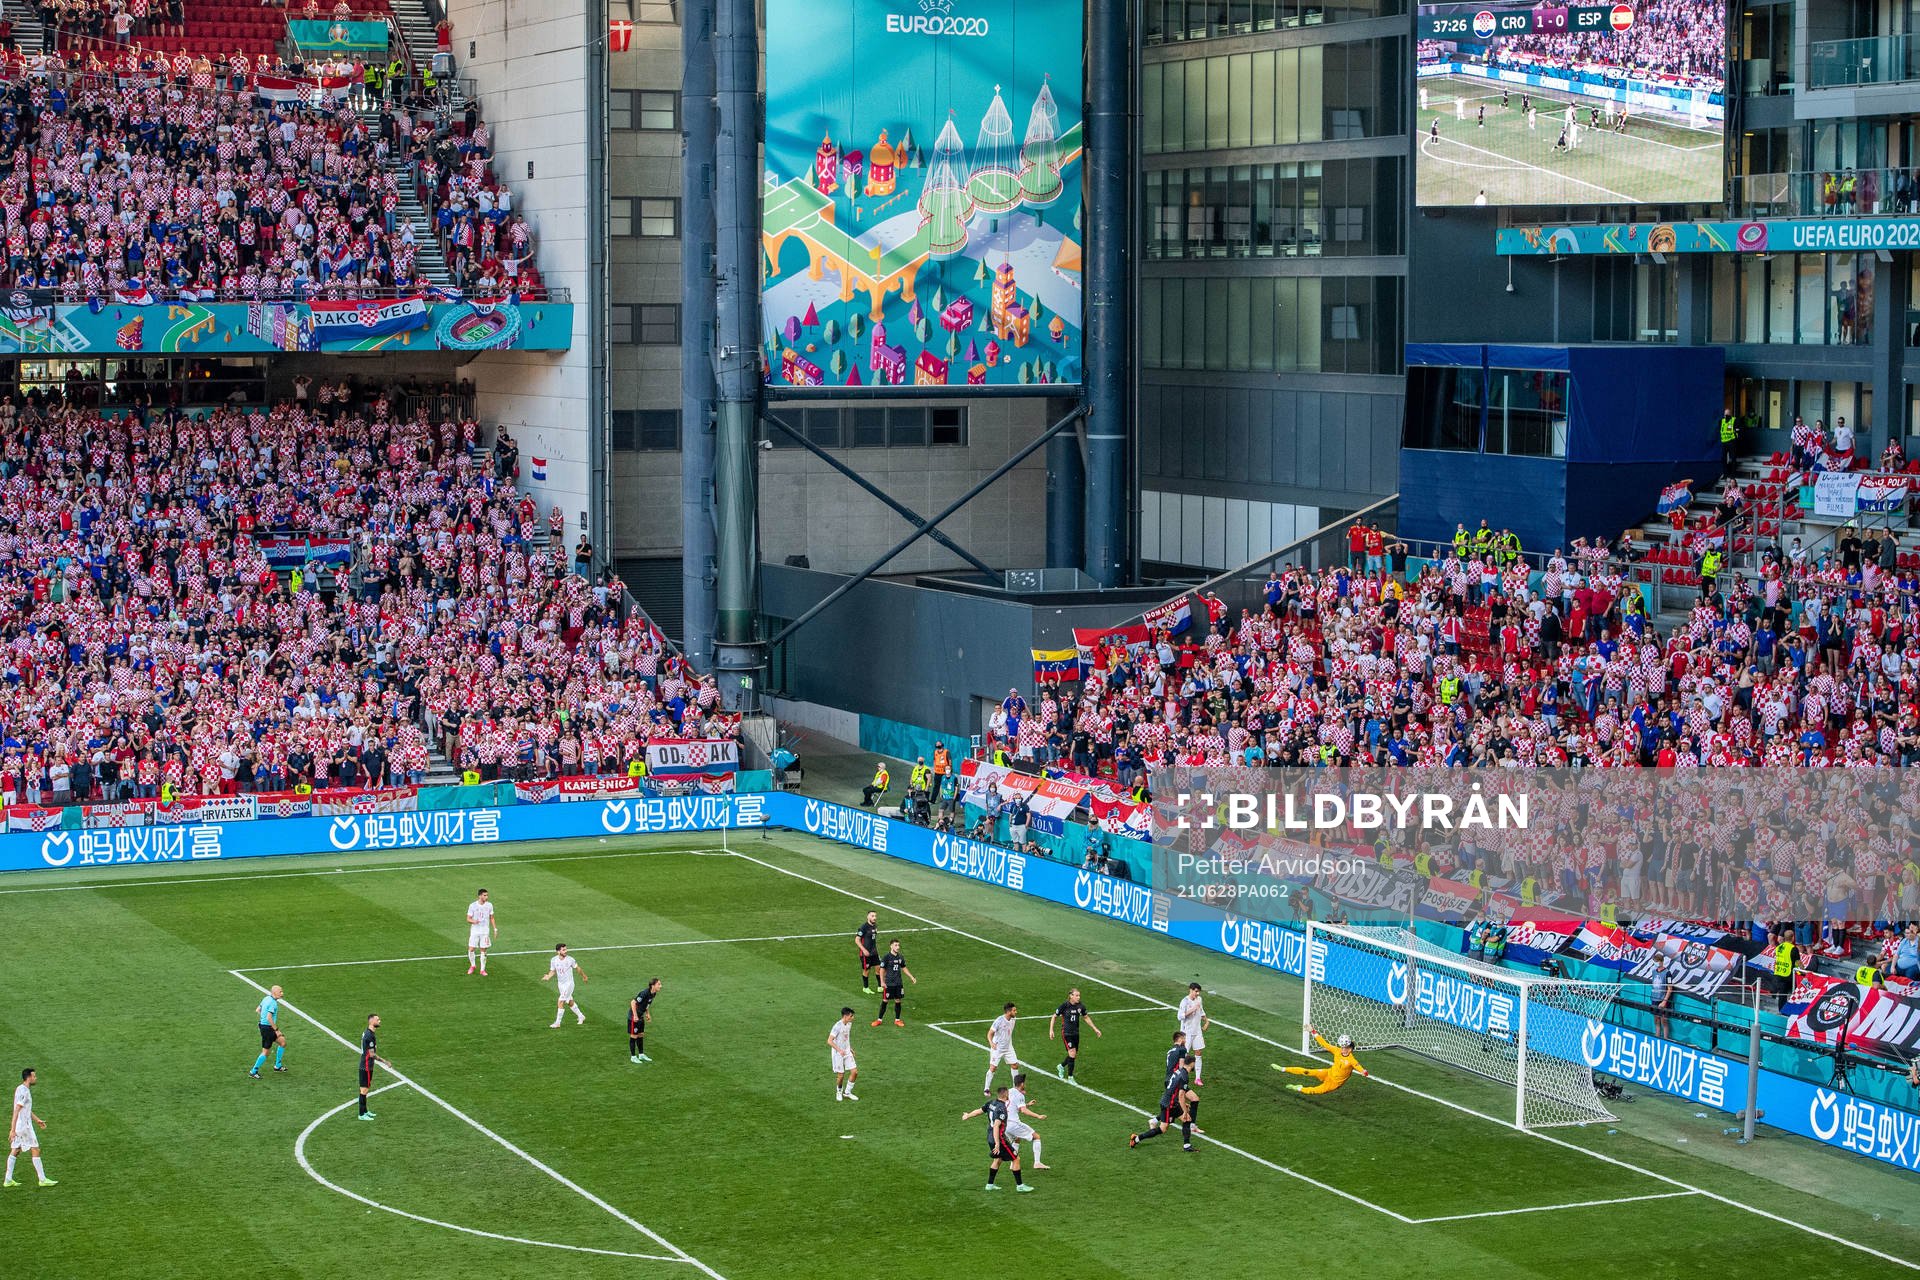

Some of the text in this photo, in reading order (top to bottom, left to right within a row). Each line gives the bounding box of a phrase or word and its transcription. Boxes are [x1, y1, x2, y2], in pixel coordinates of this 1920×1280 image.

[920, 0, 951, 12] UEFA
[1433, 19, 1467, 32] 37:26
[1502, 16, 1526, 29] CRO
[1537, 16, 1543, 27] 1
[1556, 15, 1564, 26] 0
[1579, 13, 1602, 25] ESP
[886, 14, 988, 36] EURO2020
[1793, 223, 1920, 247] UEFA EURO 202
[380, 302, 412, 319] VEC
[92, 802, 141, 813] BOBANOVA
[202, 808, 252, 820] HRVATSKA
[635, 794, 765, 831] 蚂蚁财富
[79, 824, 223, 864] 蚂蚁财富
[365, 808, 501, 848] 蚂蚁财富
[821, 802, 889, 852] 蚂蚁财富
[950, 836, 1026, 890] 蚂蚁财富
[1093, 874, 1172, 933] 蚂蚁财富
[1609, 1027, 1728, 1107] 蚂蚁财富
[1842, 1097, 1920, 1168] 蚂蚁
